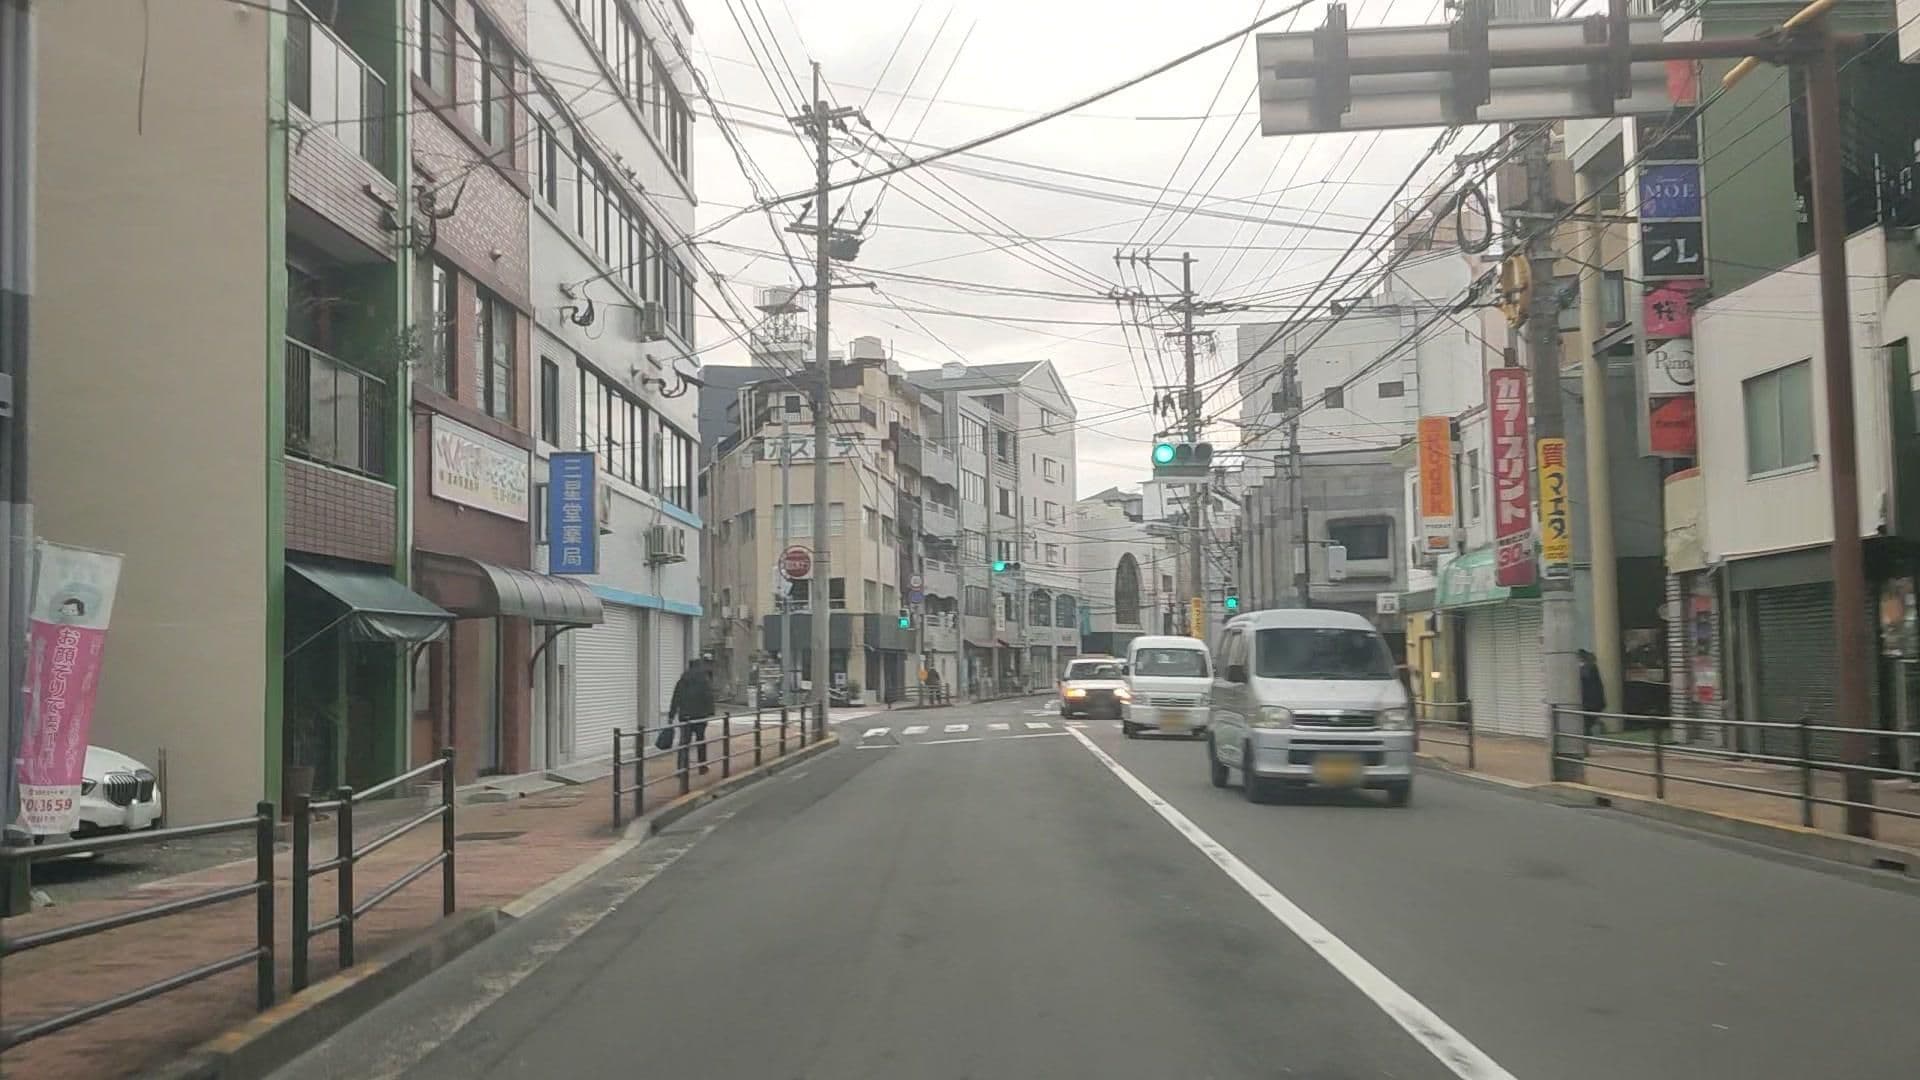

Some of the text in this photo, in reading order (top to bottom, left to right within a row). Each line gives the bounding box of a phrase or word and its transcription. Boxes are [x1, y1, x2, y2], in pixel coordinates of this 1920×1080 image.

[560, 458, 583, 566] 三星堂薬局
